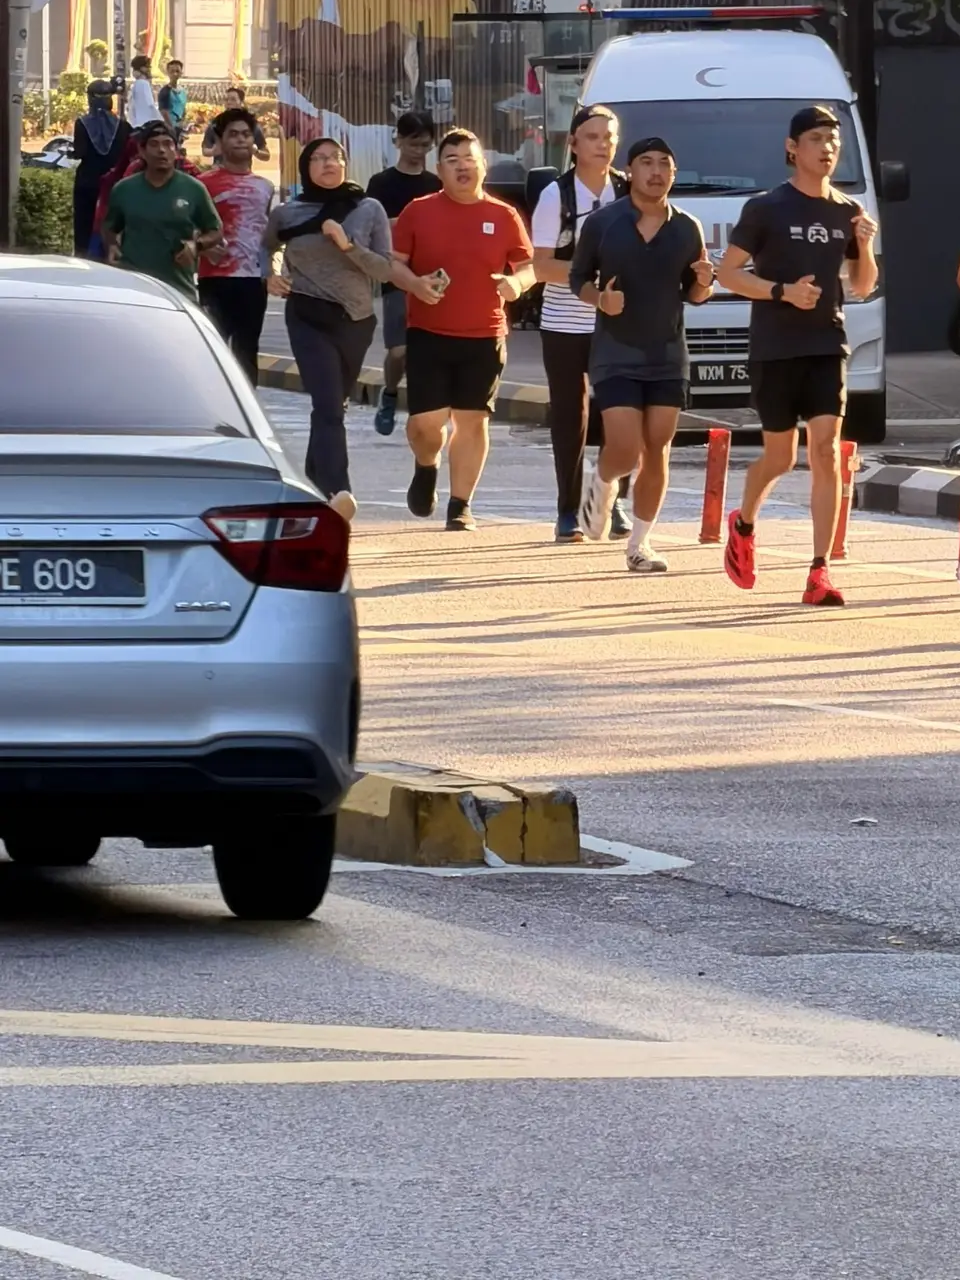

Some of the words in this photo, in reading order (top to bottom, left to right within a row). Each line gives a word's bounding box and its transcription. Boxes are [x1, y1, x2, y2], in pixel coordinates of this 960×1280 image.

[697, 365, 724, 380] WXM
[728, 365, 749, 380] 75
[0, 558, 21, 590] E
[33, 558, 96, 590] 609
